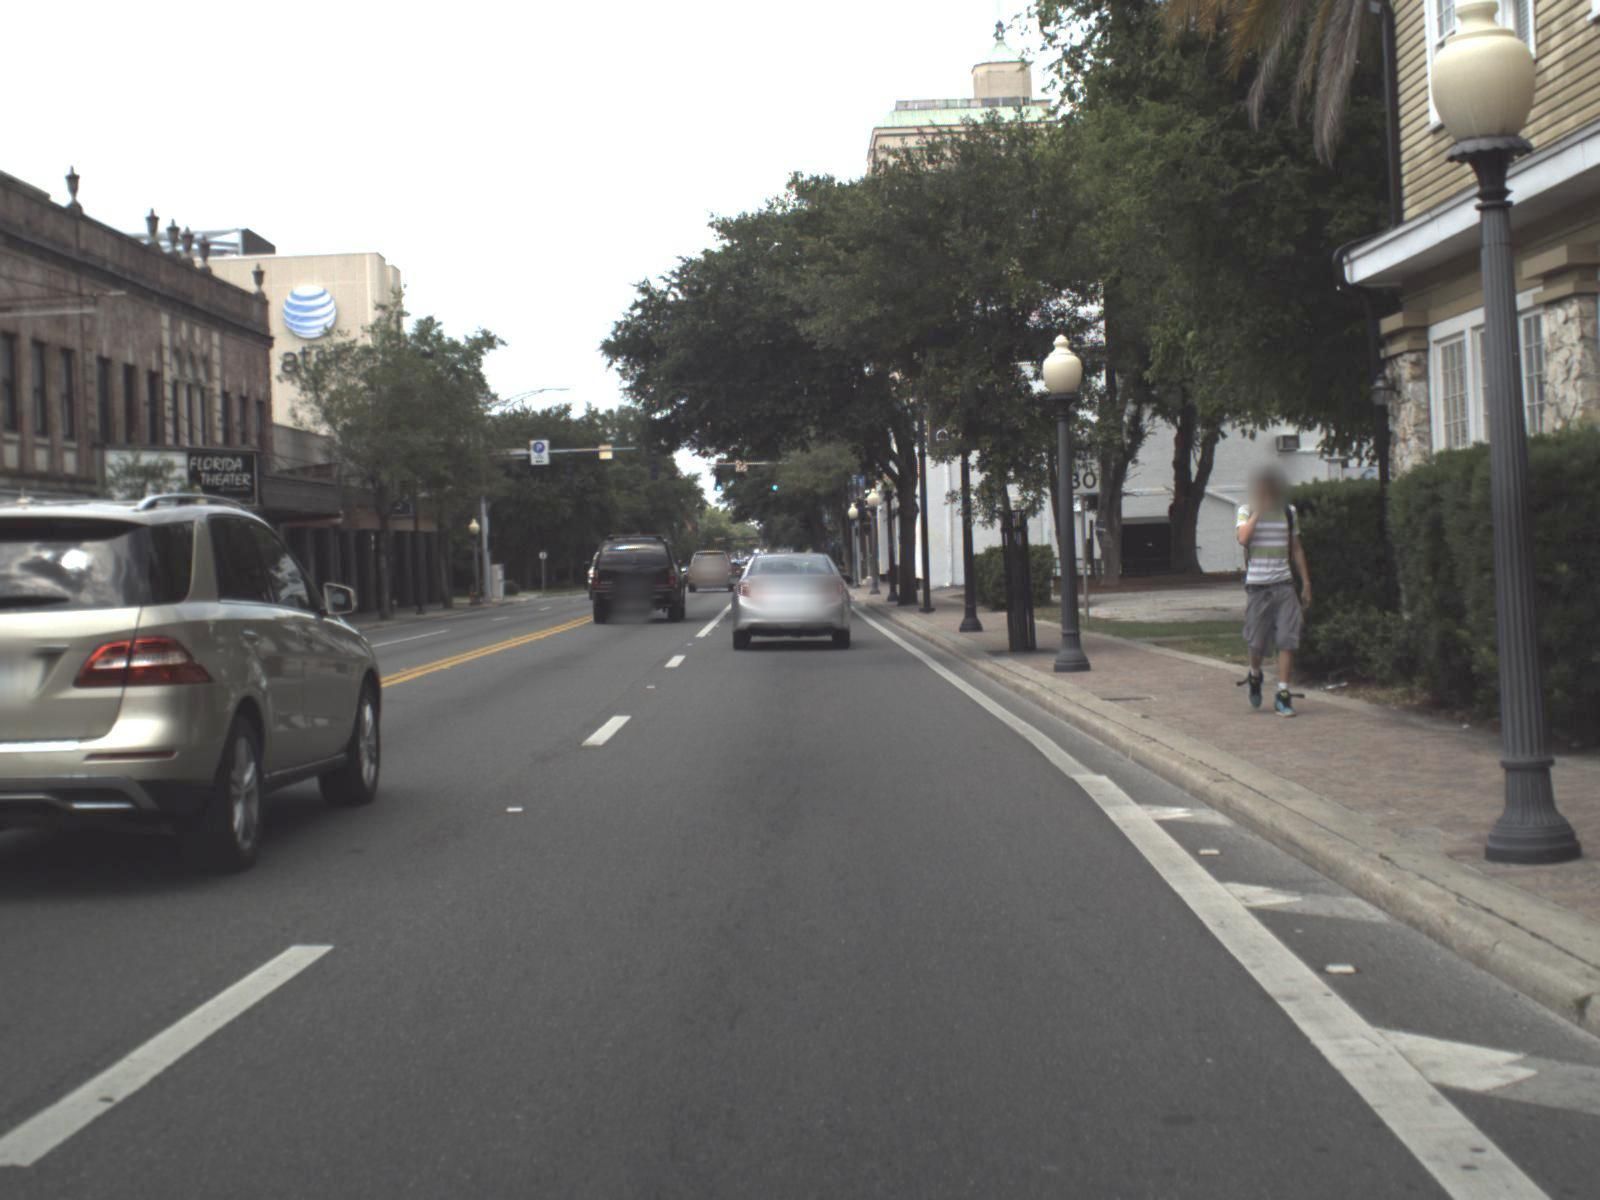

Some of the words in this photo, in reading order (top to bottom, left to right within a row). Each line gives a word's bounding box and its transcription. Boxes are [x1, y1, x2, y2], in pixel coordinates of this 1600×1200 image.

[190, 456, 242, 472] FLORIDA
[200, 472, 251, 487] THEATER
[1071, 471, 1097, 489] 30
